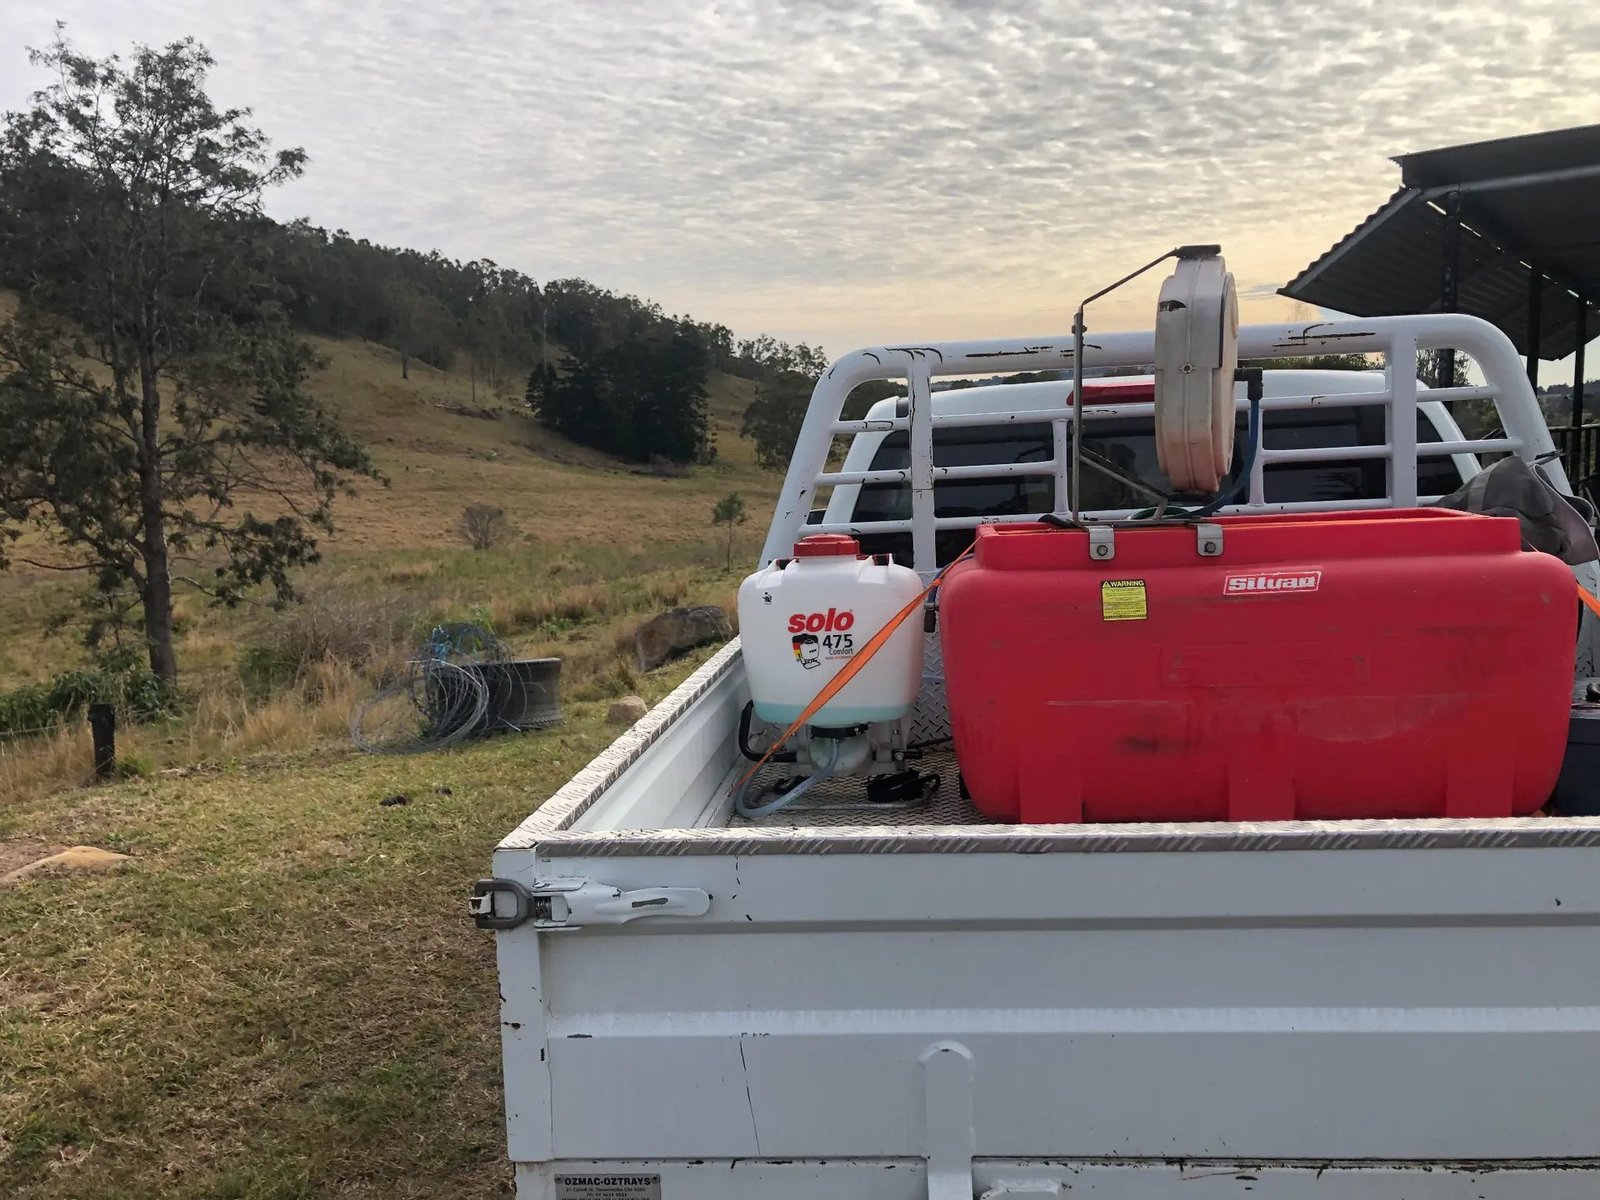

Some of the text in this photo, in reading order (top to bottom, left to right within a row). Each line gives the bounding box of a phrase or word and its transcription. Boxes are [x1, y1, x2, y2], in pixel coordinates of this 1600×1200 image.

[788, 608, 854, 633] solo
[822, 634, 853, 648] 475
[829, 647, 853, 655] Comfort
[564, 1177, 651, 1186] OZMAC-OZTRAYS
